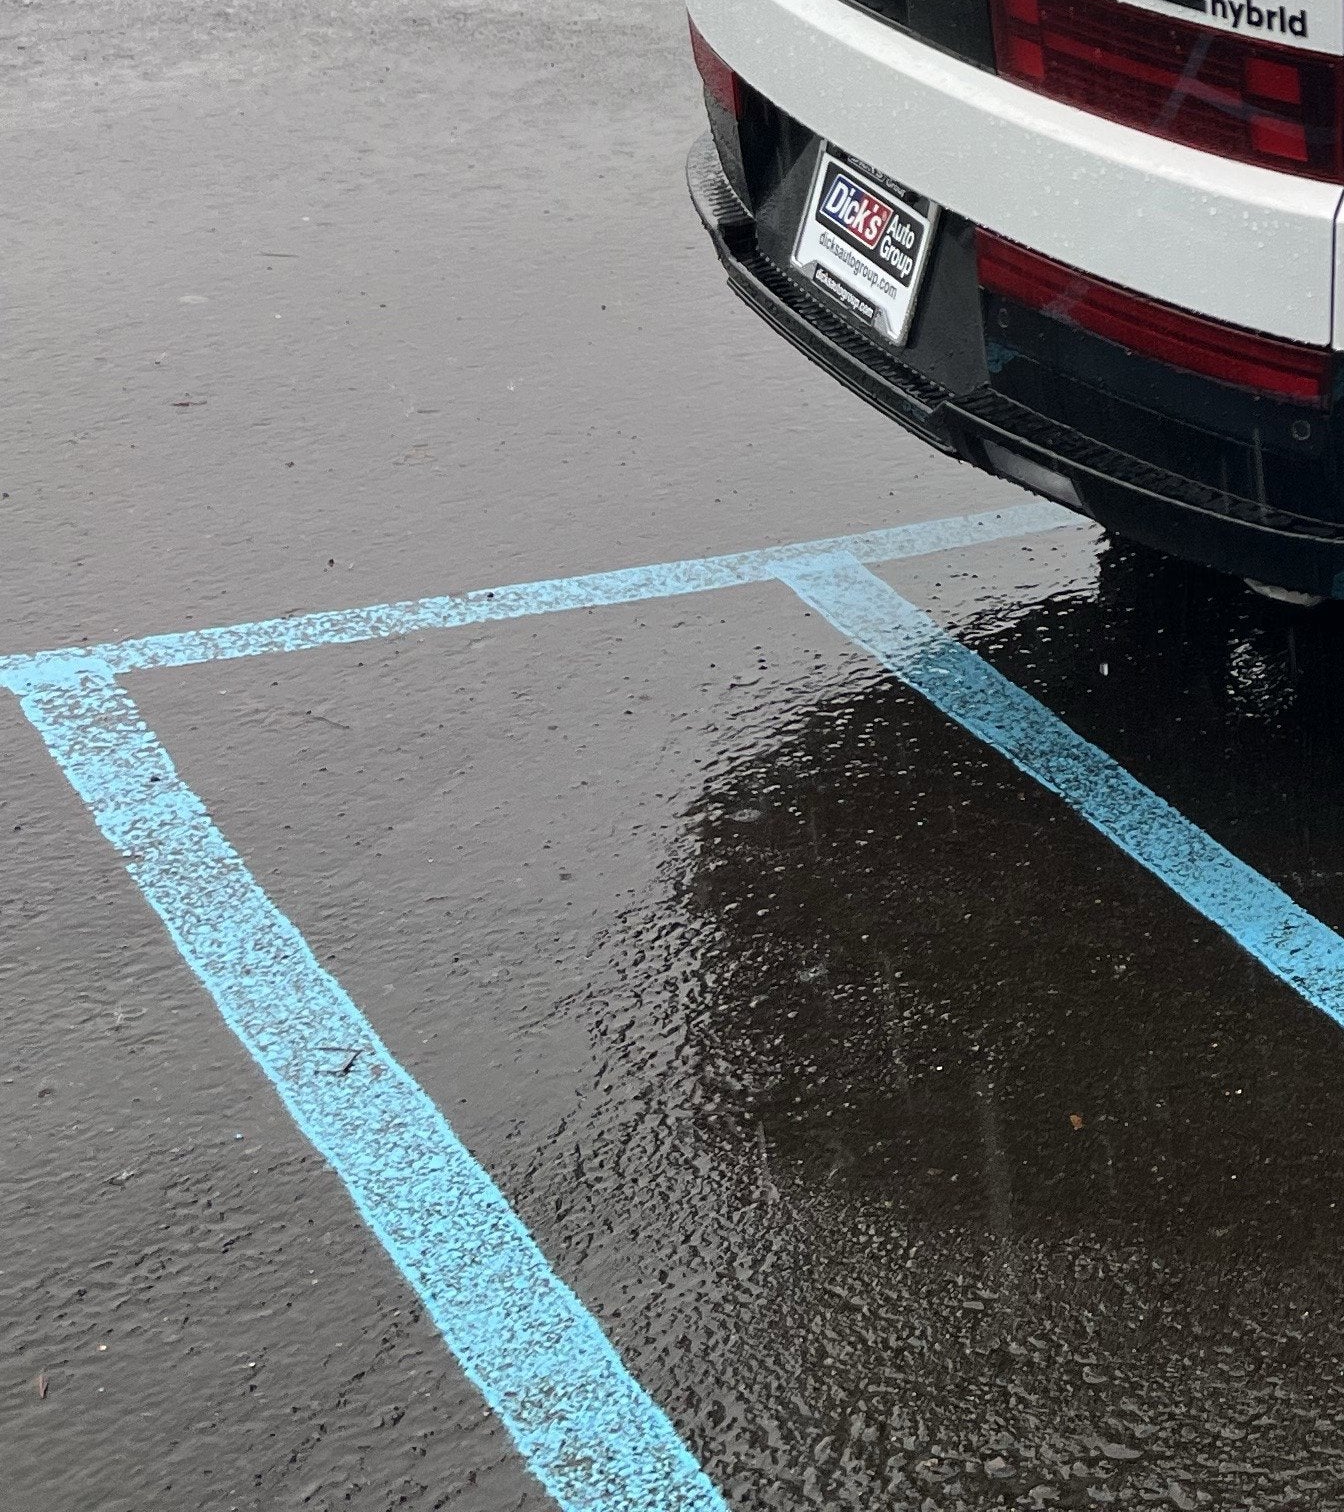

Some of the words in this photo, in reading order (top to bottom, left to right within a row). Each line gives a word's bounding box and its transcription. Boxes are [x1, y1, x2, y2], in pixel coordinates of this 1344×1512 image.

[826, 180, 884, 241] Dick's
[886, 214, 915, 249] Auto
[818, 231, 898, 300] dicksautogroup.com
[879, 236, 914, 278] Group
